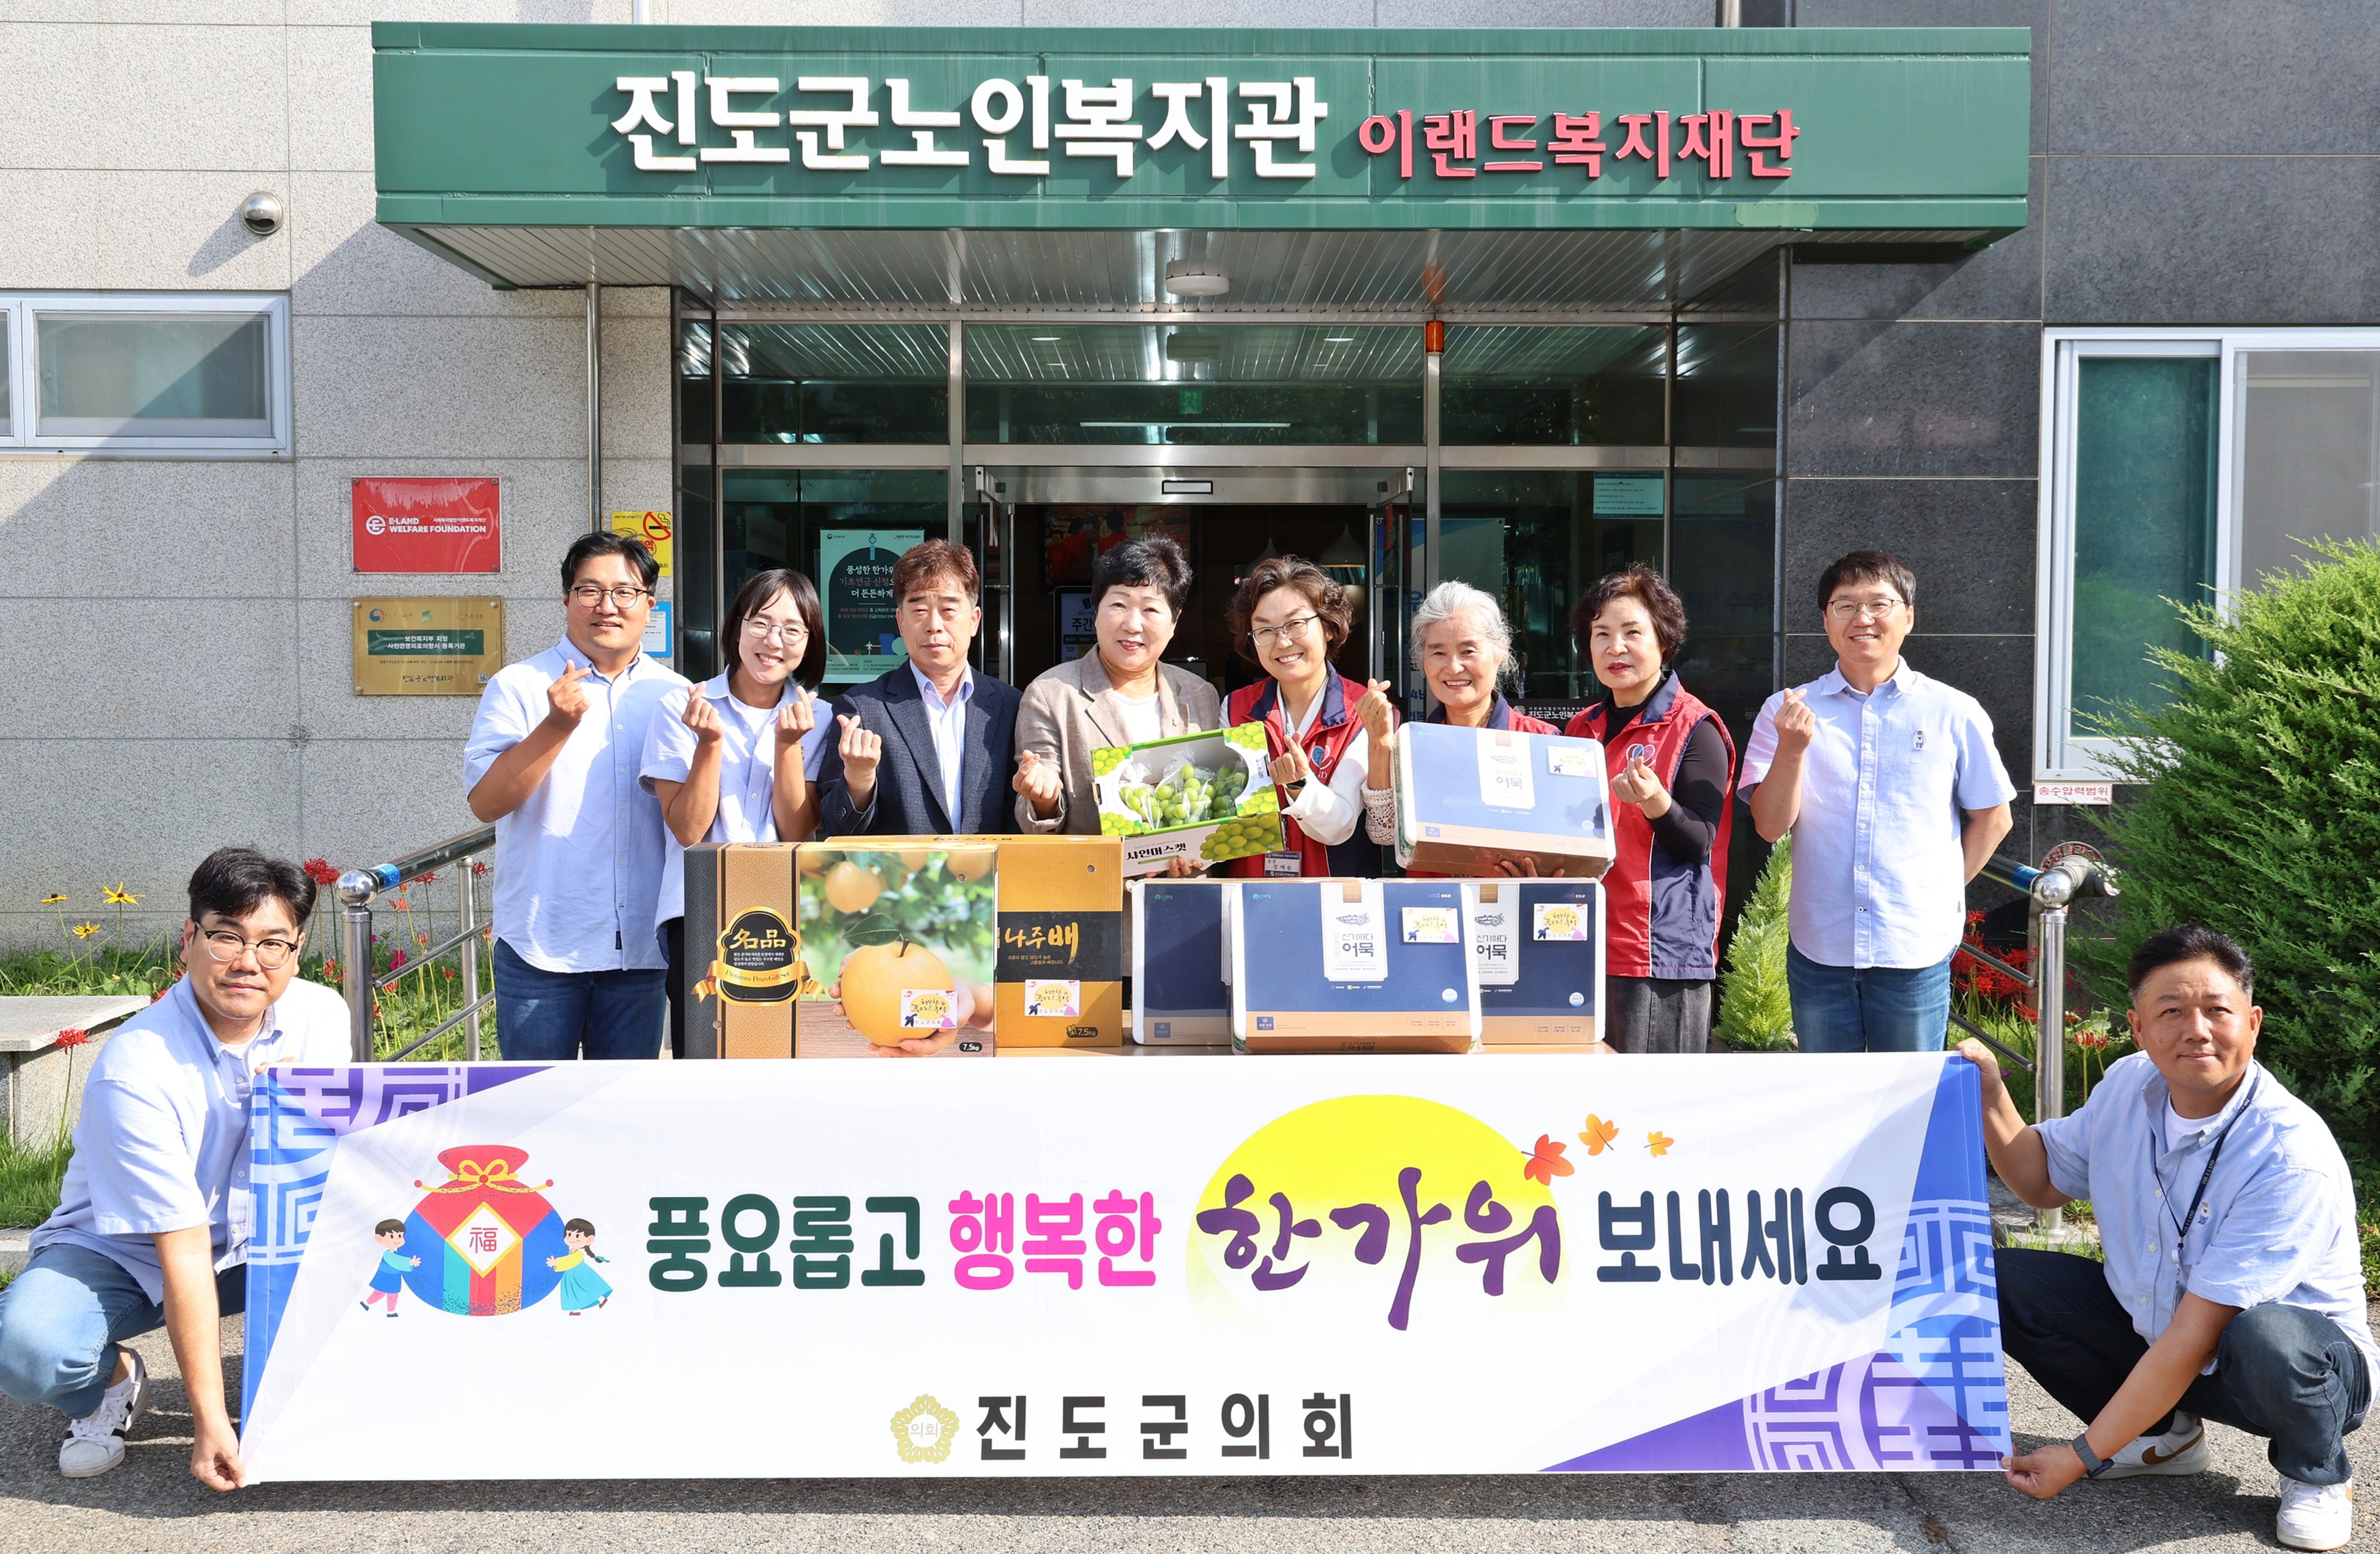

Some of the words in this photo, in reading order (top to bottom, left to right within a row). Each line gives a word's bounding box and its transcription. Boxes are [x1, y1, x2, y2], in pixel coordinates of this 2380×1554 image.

[611, 71, 1327, 177] 진도군노인복지관
[1359, 109, 1799, 178] 이랜드복지재단
[846, 565, 870, 574] 풍성한
[839, 576, 872, 587] 기초연금
[851, 588, 859, 598] 더
[861, 588, 893, 598] 든든하게
[1496, 776, 1524, 790] 어묵
[2039, 787, 2108, 795] 송수압력범위
[729, 928, 786, 950] 名品
[1342, 942, 1375, 958] 어묵
[1477, 944, 1507, 960] 어묵
[725, 969, 751, 981] Premium
[1077, 1028, 1096, 1036] 7.5kg
[469, 1226, 497, 1254] 福
[647, 1193, 925, 1292] 풍요롭고
[948, 1189, 1162, 1290] 행복한
[1196, 1166, 1561, 1331] 한가위
[1597, 1187, 1882, 1286] 보내세요
[910, 1422, 938, 1438] 의회
